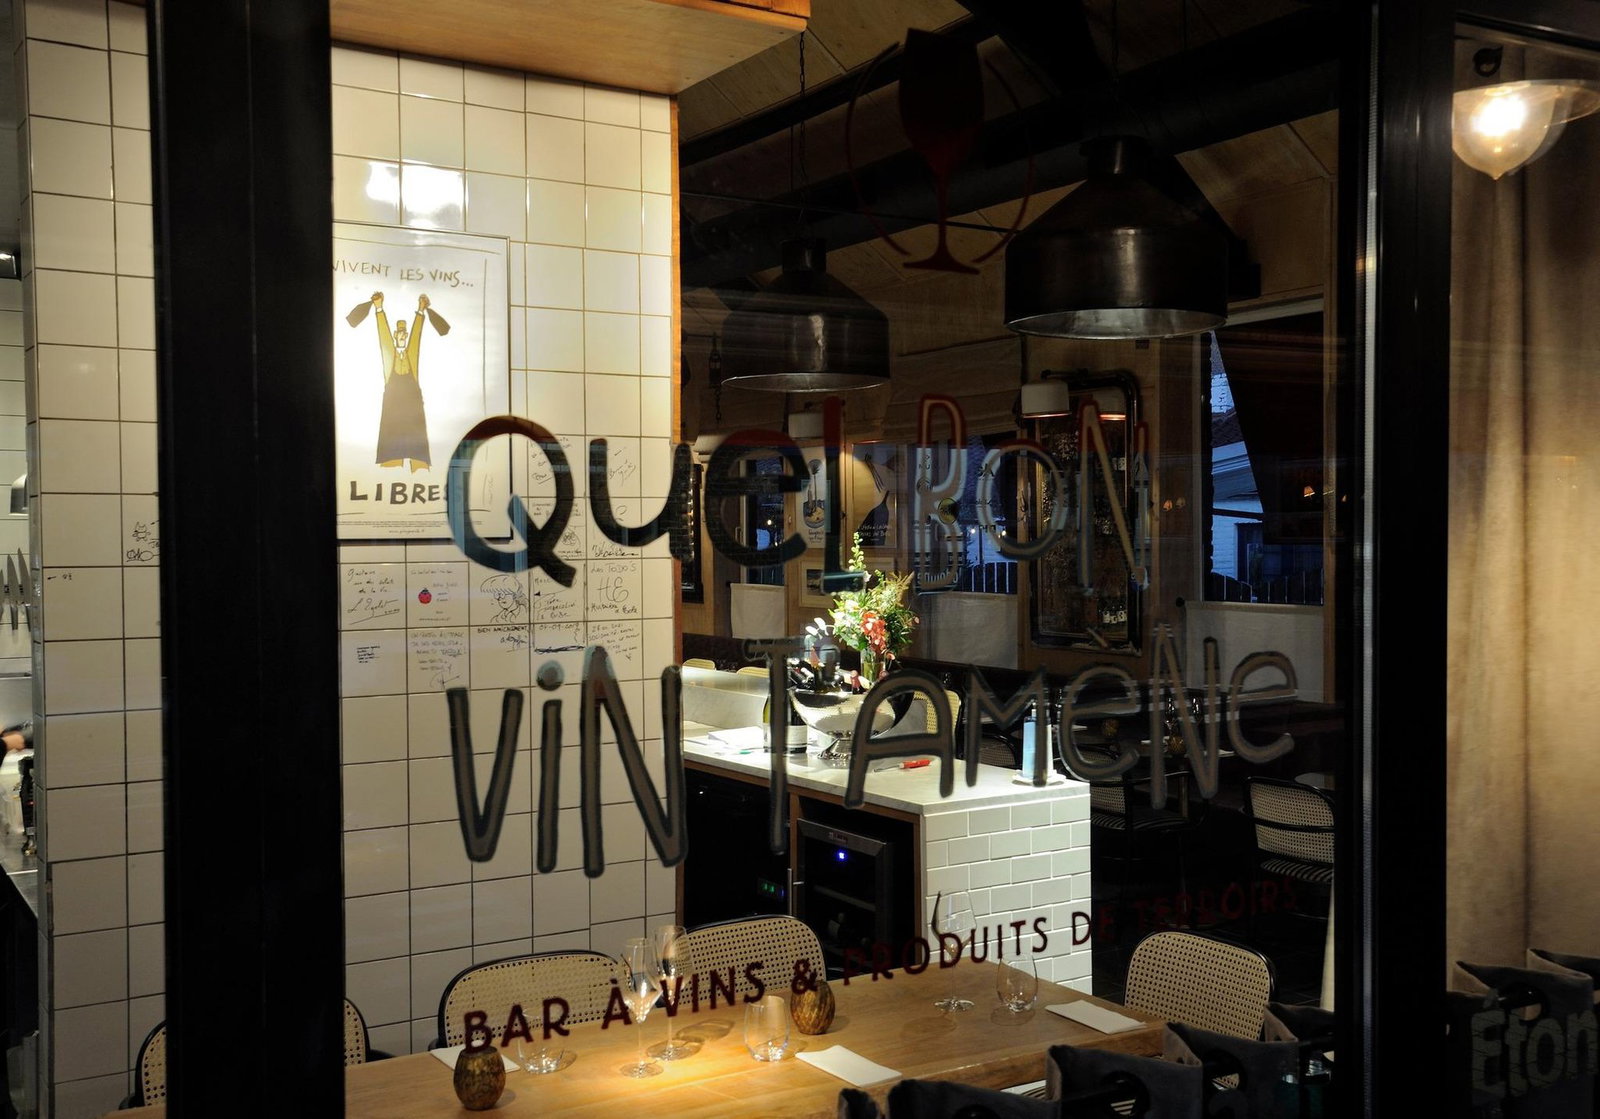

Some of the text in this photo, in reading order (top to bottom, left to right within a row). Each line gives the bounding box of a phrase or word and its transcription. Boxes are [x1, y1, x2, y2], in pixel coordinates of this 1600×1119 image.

[400, 269, 424, 281] LES
[350, 480, 449, 505] LIBRE
[463, 996, 571, 1050] BAR
[601, 978, 633, 1030] À
[659, 960, 766, 1018] VINS
[790, 958, 819, 995] &
[843, 917, 1048, 985] PRODUITS
[1071, 902, 1119, 945] DE
